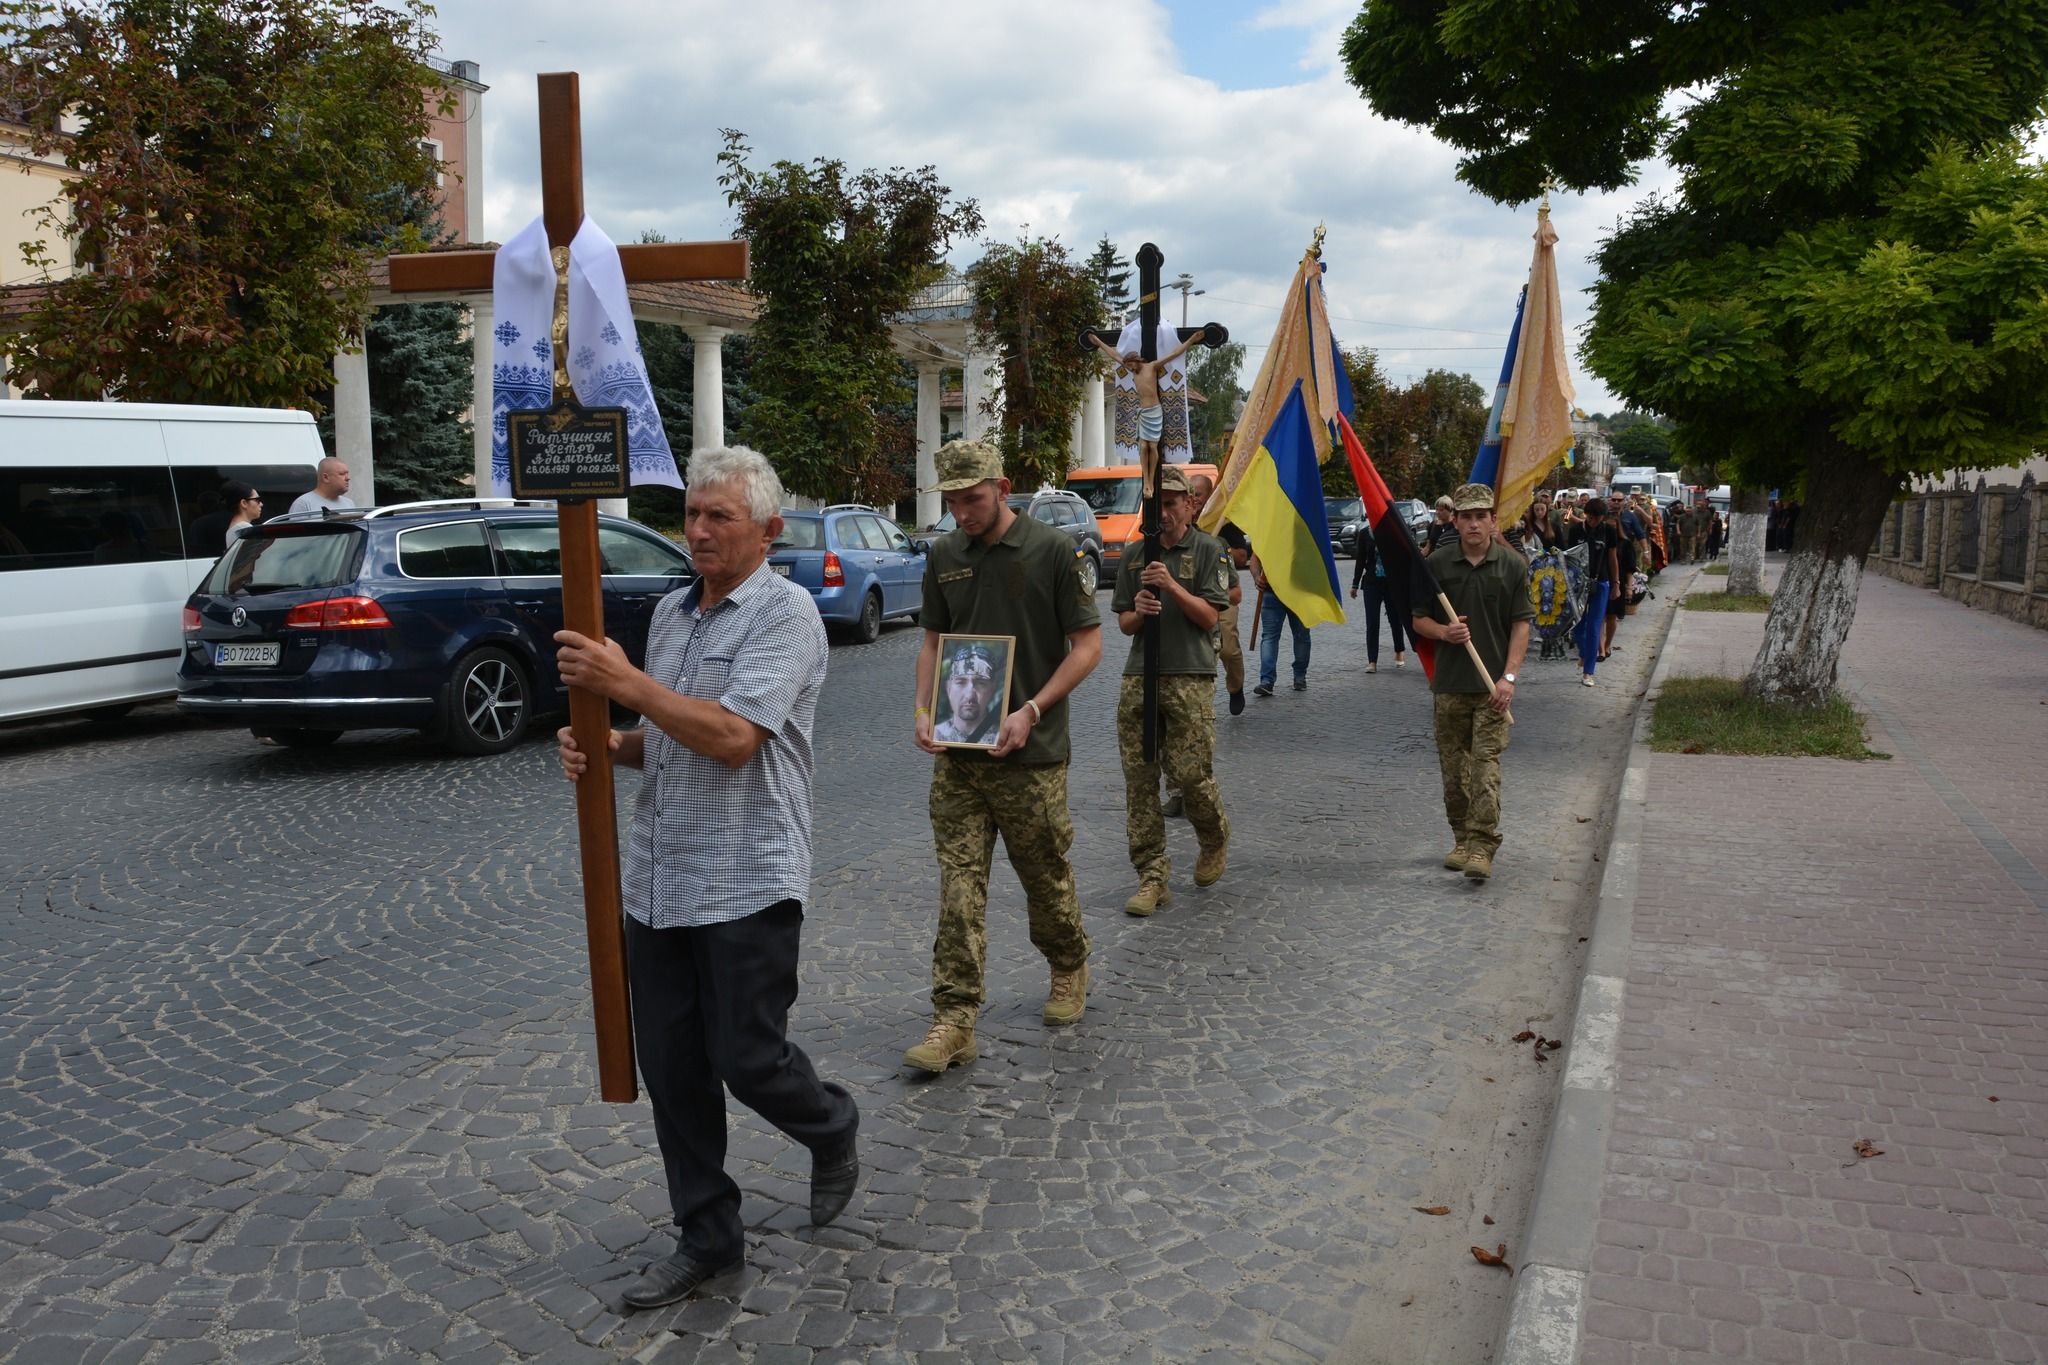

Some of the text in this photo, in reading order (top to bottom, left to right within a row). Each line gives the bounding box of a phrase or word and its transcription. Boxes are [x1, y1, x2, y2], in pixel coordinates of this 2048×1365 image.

[224, 647, 277, 661] BO 7222 BK
